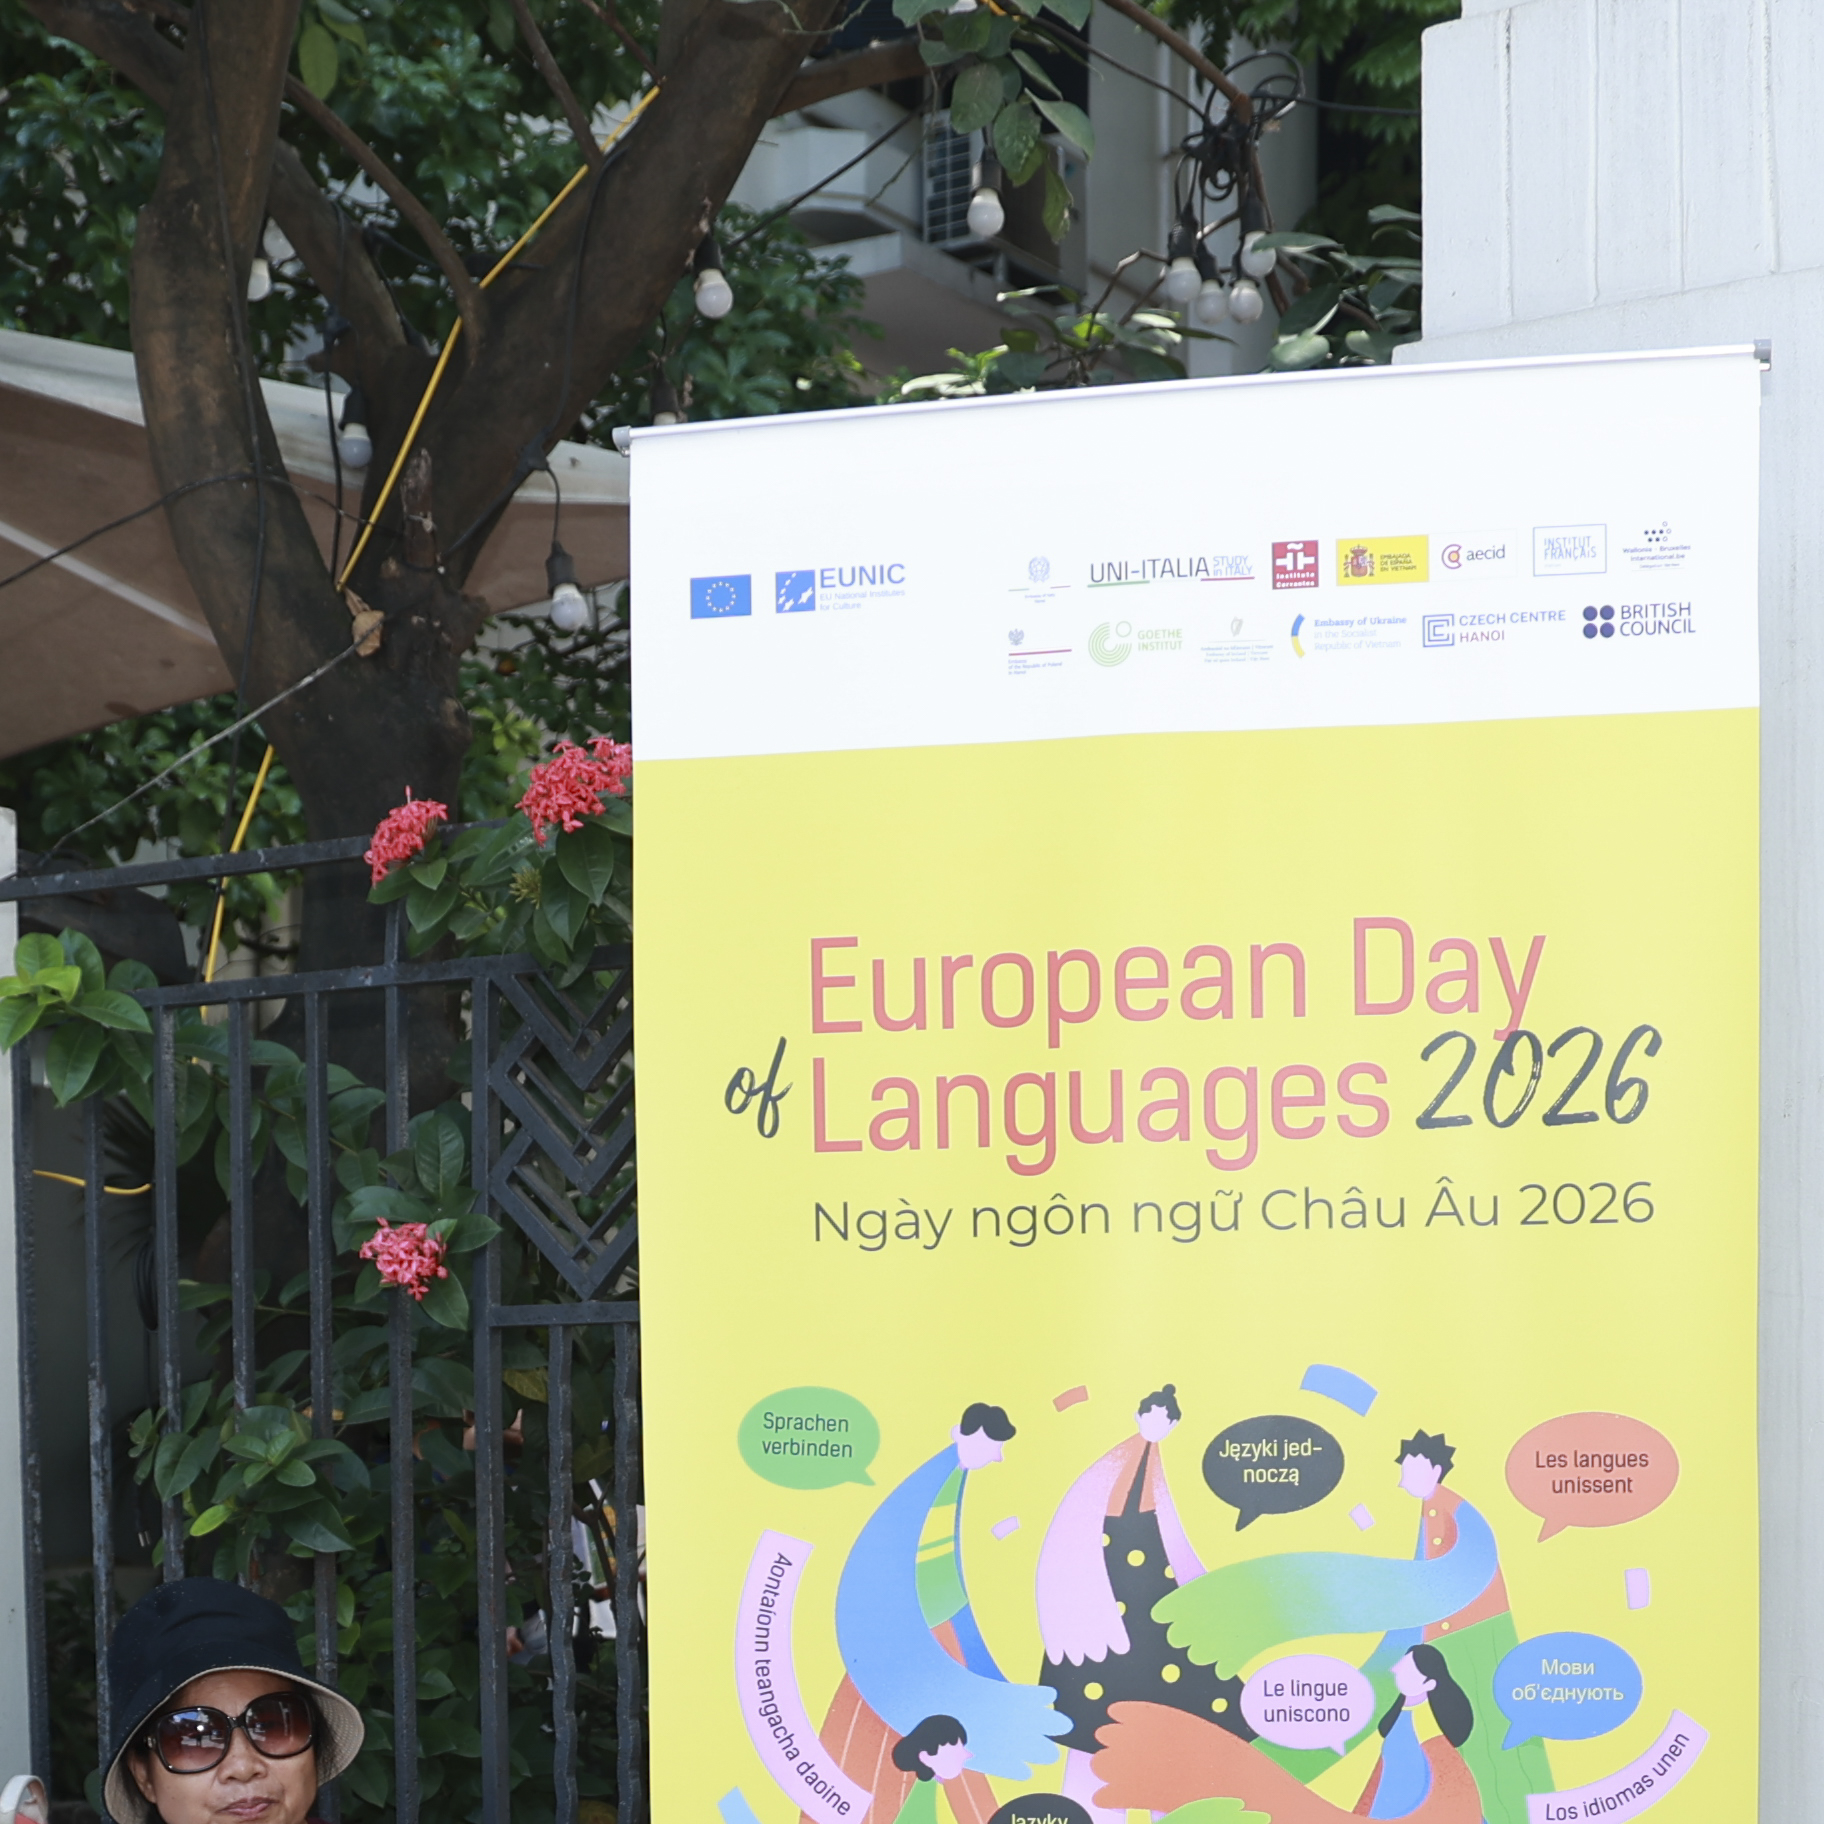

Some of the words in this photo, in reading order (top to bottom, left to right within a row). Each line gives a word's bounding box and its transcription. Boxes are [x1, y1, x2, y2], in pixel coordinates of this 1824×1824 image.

[1544, 536, 1592, 549] INSTITUT
[1213, 555, 1249, 567] STUDY
[1466, 543, 1506, 562] aecid
[819, 563, 906, 589] EUNIC
[1090, 556, 1210, 583] UNI-ITALIA
[1225, 565, 1253, 577] ITALY
[835, 590, 867, 600] National
[833, 602, 861, 611] Culture
[1621, 602, 1692, 619] BRITISH
[1314, 618, 1354, 628] Embassy
[1357, 617, 1367, 626] of
[1369, 616, 1407, 626] Ukraine
[1459, 613, 1505, 627] CZECH
[1510, 610, 1566, 625] CENTRE
[1620, 619, 1696, 637] COUNCIL
[1137, 628, 1183, 640] GOETHE
[1460, 630, 1505, 643] HANOI
[1137, 640, 1183, 652] INSTITUT
[810, 935, 1307, 1050] European
[1353, 916, 1547, 1045] Day
[724, 1035, 793, 1139] of
[812, 1056, 1391, 1177] Languages
[1414, 1022, 1664, 1131] 2026
[814, 1197, 954, 1252] Ngày
[972, 1192, 1110, 1248] ngôn
[1133, 1189, 1244, 1244] ngữ
[1261, 1185, 1405, 1231] Châu
[1424, 1175, 1499, 1228] Âu
[1518, 1181, 1655, 1226] 2026
[763, 1411, 849, 1434] Sprachen
[761, 1437, 853, 1458] verbinden
[1218, 1438, 1278, 1463] Języki
[1535, 1450, 1568, 1469] Les
[1573, 1449, 1649, 1474] langues
[1243, 1467, 1300, 1487] noczą
[1551, 1475, 1633, 1494] unissent
[754, 1552, 792, 1653] Aontaíonn
[1541, 1658, 1597, 1676] Мови
[1263, 1679, 1285, 1698] Le
[1290, 1678, 1348, 1702] lingue
[755, 1658, 800, 1762] teangacha
[1263, 1707, 1350, 1723] uniscono
[1546, 1802, 1579, 1822] Los
[1583, 1773, 1655, 1819] idiomas
[1652, 1731, 1691, 1780] unen
[796, 1760, 852, 1817] daoine
